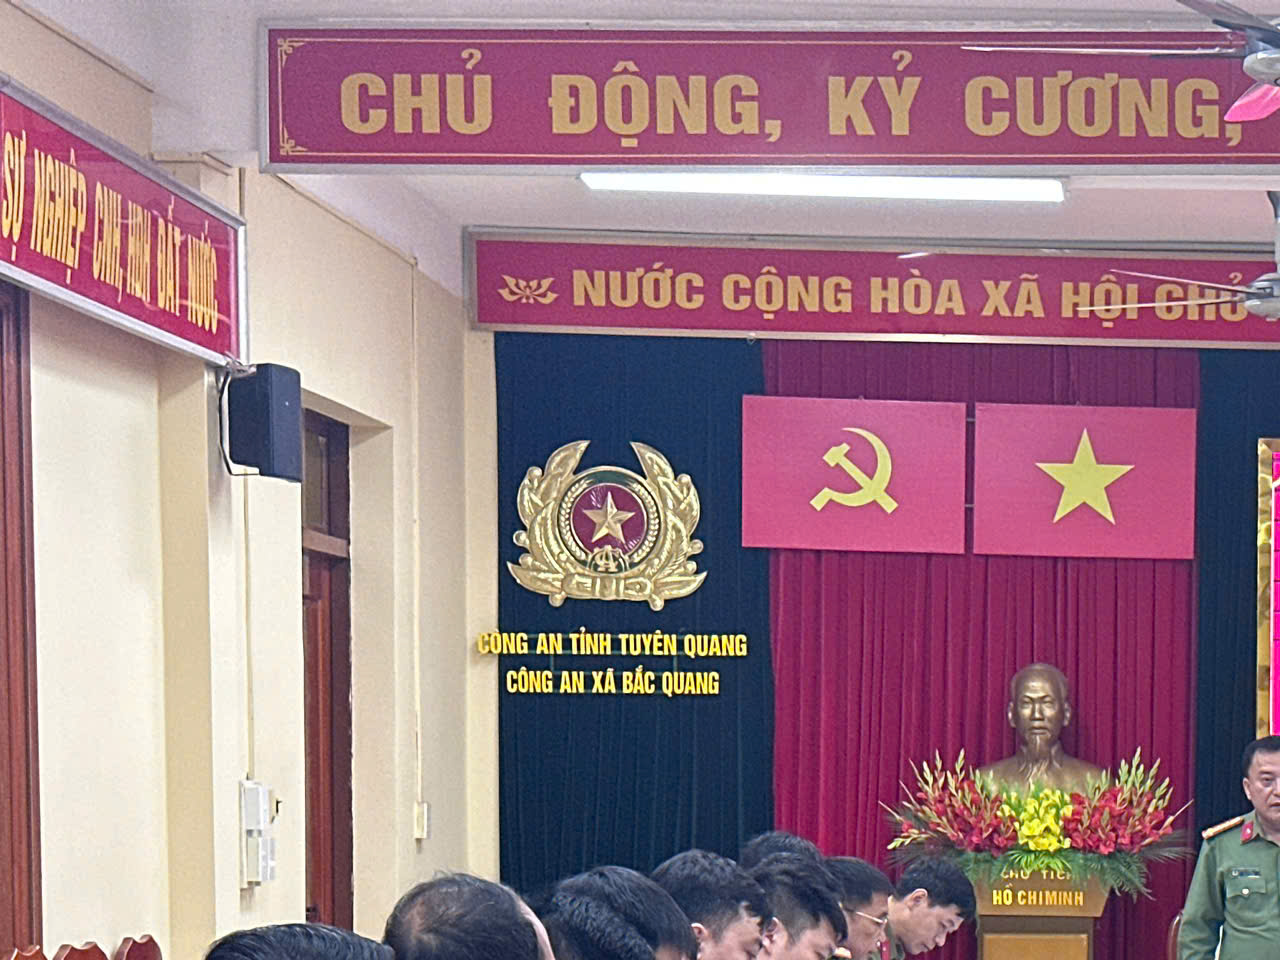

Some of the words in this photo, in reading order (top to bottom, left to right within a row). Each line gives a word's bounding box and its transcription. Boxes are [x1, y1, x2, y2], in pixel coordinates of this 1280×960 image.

[340, 48, 493, 135] CHỦ
[548, 60, 782, 147] ĐỘNG,
[827, 50, 922, 136] KỶ
[964, 70, 1243, 146] CƯƠNG,
[2, 129, 27, 261] SỰ
[30, 147, 87, 284] NGHIỆP
[188, 220, 218, 335] NƯỚC
[572, 262, 704, 309] NƯỚC
[721, 266, 852, 320] CỘNG
[870, 269, 966, 315] HÒA
[980, 274, 1045, 318] XÃ
[1061, 275, 1138, 327] HỘI
[1154, 271, 1248, 322] CHỦ
[478, 629, 528, 655] CÔNG
[536, 634, 562, 655] AN
[569, 626, 611, 656] TỈNH
[618, 629, 677, 656] TUYÊN
[684, 634, 747, 658] QUANG
[506, 667, 553, 693] CÔNG
[560, 671, 584, 693] AN
[592, 667, 616, 693] XÃ
[622, 665, 655, 694] BẮC
[662, 672, 720, 697] QUANG
